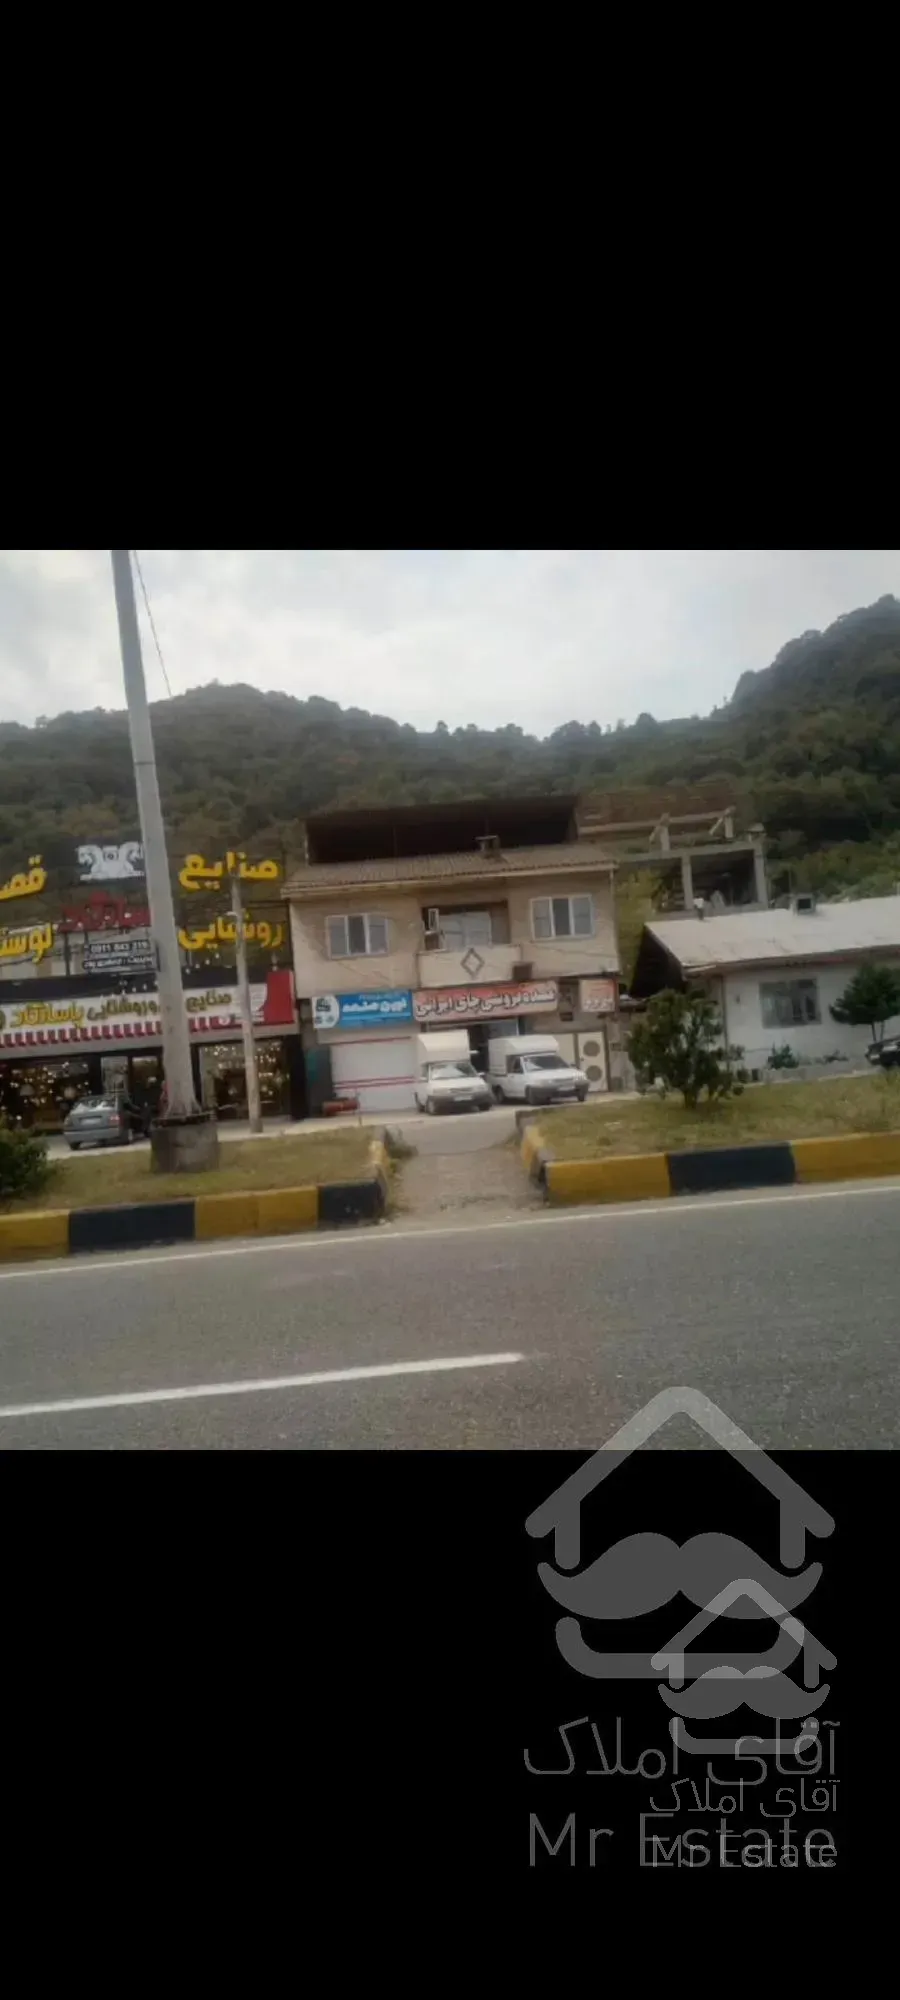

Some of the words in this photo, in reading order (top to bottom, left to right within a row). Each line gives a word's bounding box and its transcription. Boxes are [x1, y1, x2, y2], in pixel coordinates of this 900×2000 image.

[0, 855, 47, 900] قص
[178, 851, 279, 890] صنایع
[178, 911, 284, 950] روشنایی
[415, 995, 453, 1017] ایرانی
[455, 991, 481, 1014] چای
